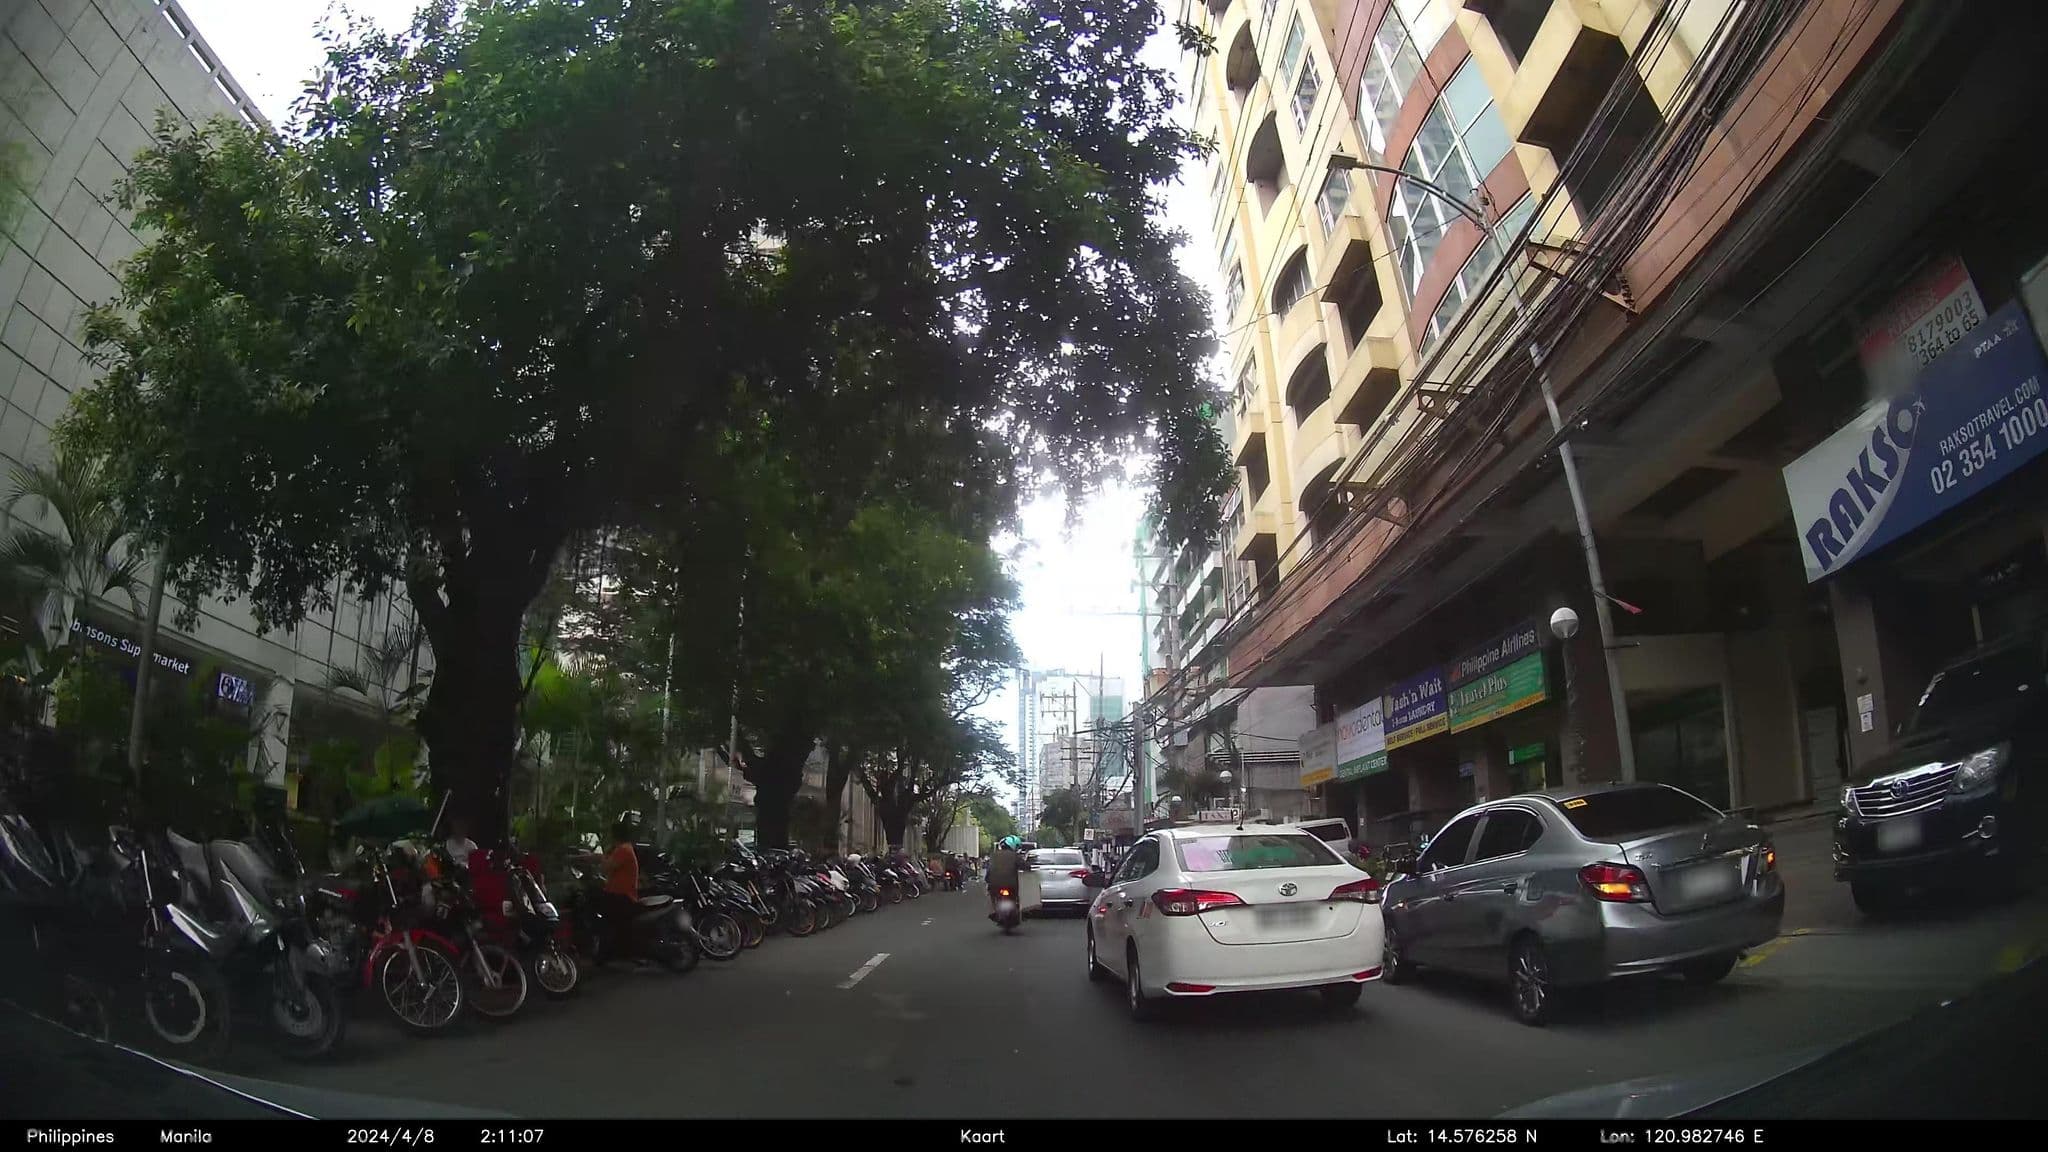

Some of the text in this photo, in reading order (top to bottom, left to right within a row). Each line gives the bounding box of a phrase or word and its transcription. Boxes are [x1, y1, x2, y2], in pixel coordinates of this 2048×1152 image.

[1946, 327, 1960, 345] to
[1962, 309, 1981, 335] 65
[1930, 396, 2048, 496] 02 354 1000
[1939, 375, 2041, 457] RAKSOTRAVEL.COM
[1805, 392, 1914, 572] RAKSO
[1461, 628, 1535, 678] Philippine Airlines
[1418, 677, 1443, 700] Wait
